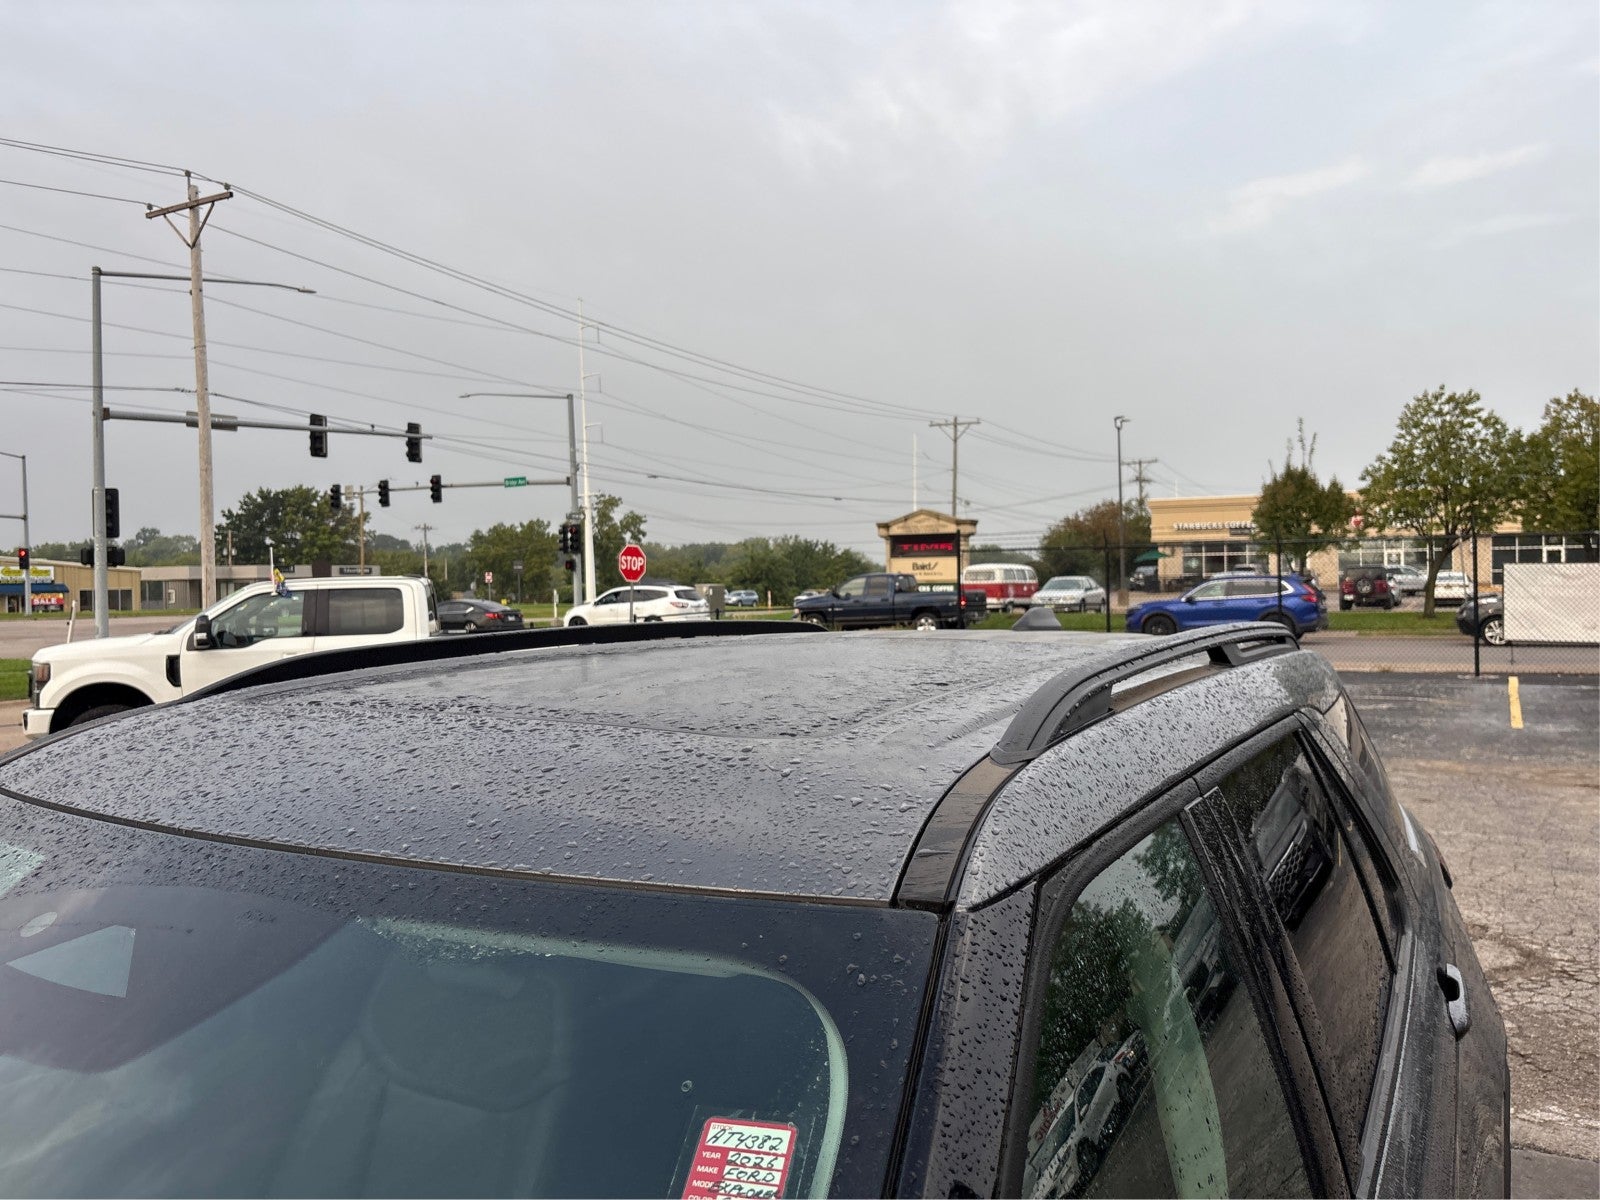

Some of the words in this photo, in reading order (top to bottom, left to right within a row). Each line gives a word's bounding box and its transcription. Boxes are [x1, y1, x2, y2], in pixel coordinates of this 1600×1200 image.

[1173, 522, 1223, 530] STARBUCKS
[621, 555, 644, 571] STOP
[33, 597, 57, 605] SALE
[711, 1123, 733, 1131] STOCK
[702, 1151, 721, 1159] YEAR
[727, 1152, 778, 1168] 2026
[696, 1165, 719, 1174] MAKE
[722, 1168, 775, 1182] FORD
[692, 1180, 716, 1188] MODE
